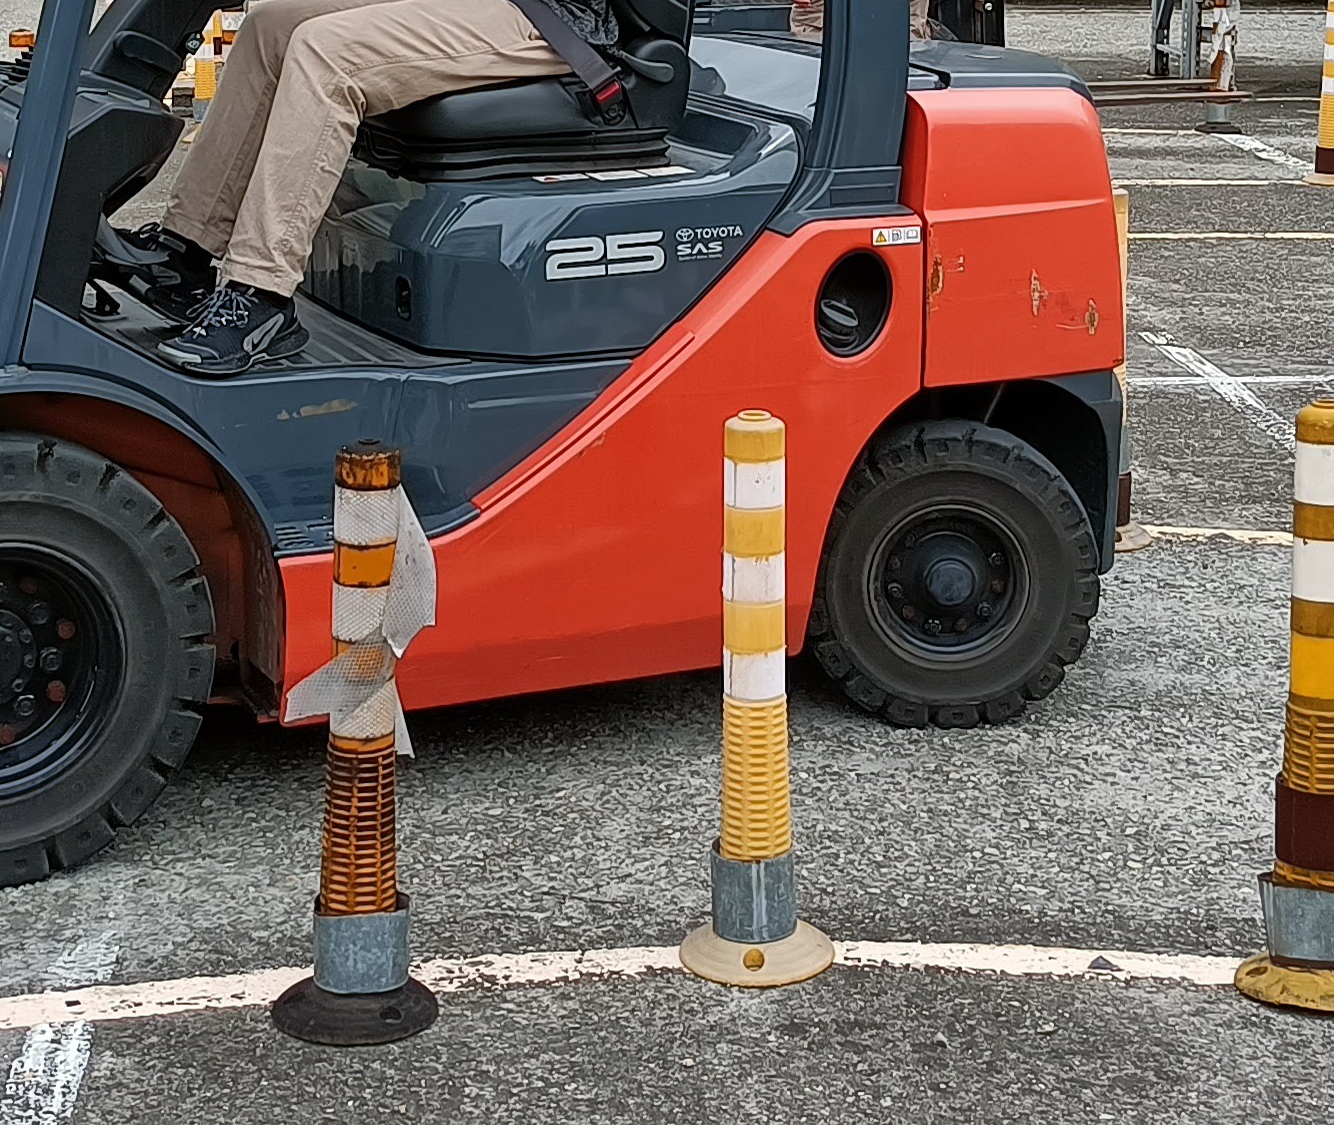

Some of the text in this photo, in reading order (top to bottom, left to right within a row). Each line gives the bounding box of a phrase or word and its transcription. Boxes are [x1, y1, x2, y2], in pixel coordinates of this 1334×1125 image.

[695, 225, 743, 239] TOYOTA
[676, 241, 723, 255] SAS
[546, 231, 665, 280] 25
